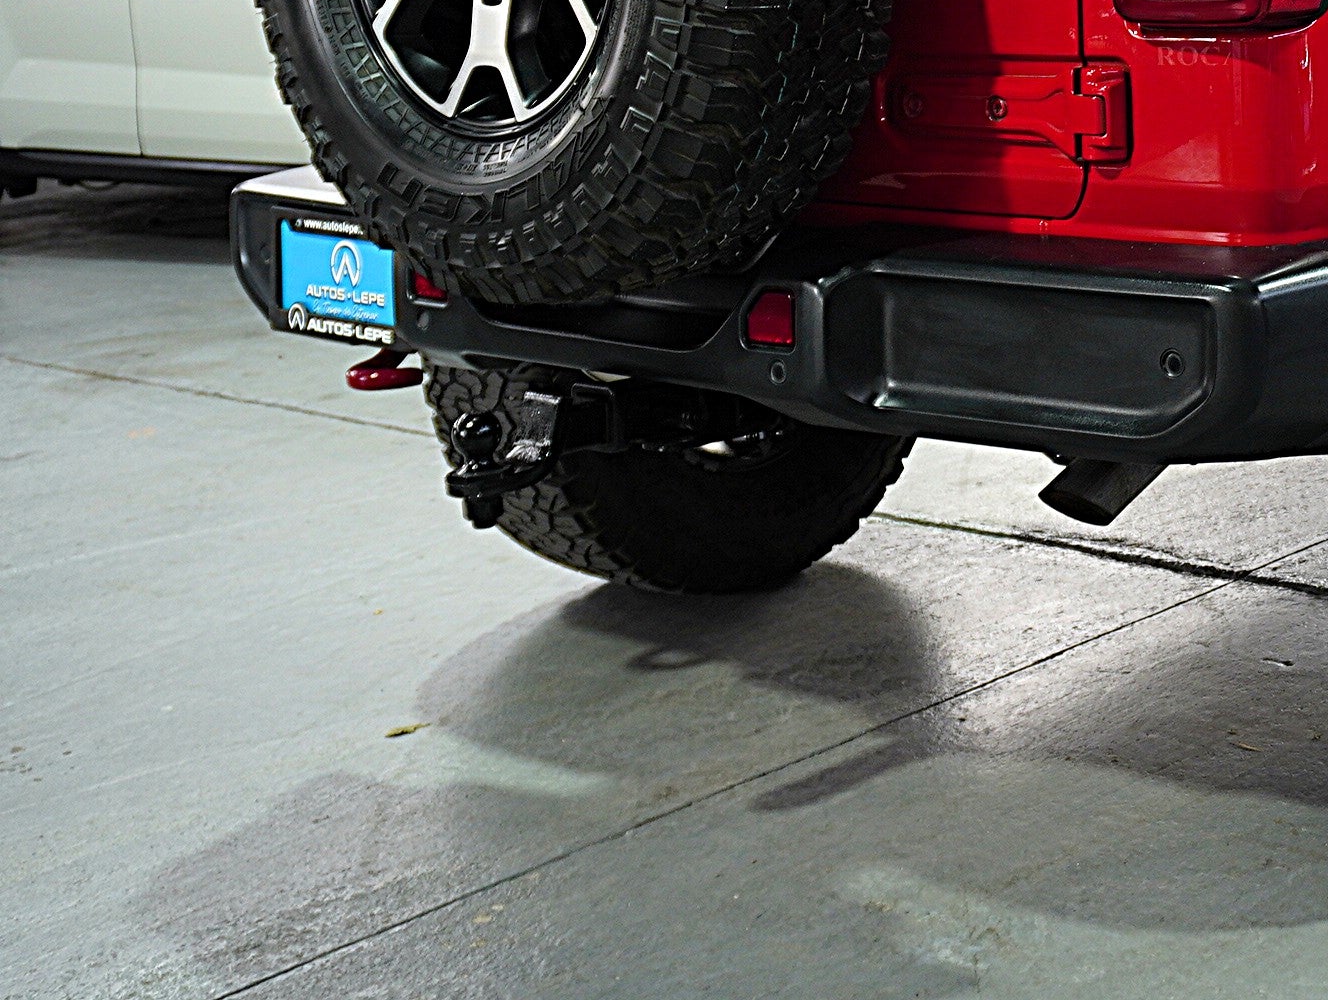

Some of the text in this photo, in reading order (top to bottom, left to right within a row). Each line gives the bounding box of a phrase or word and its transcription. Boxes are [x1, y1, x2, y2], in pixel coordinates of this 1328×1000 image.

[306, 284, 386, 308] AUTOS LEPE
[307, 317, 394, 345] AUTOS LEPE
